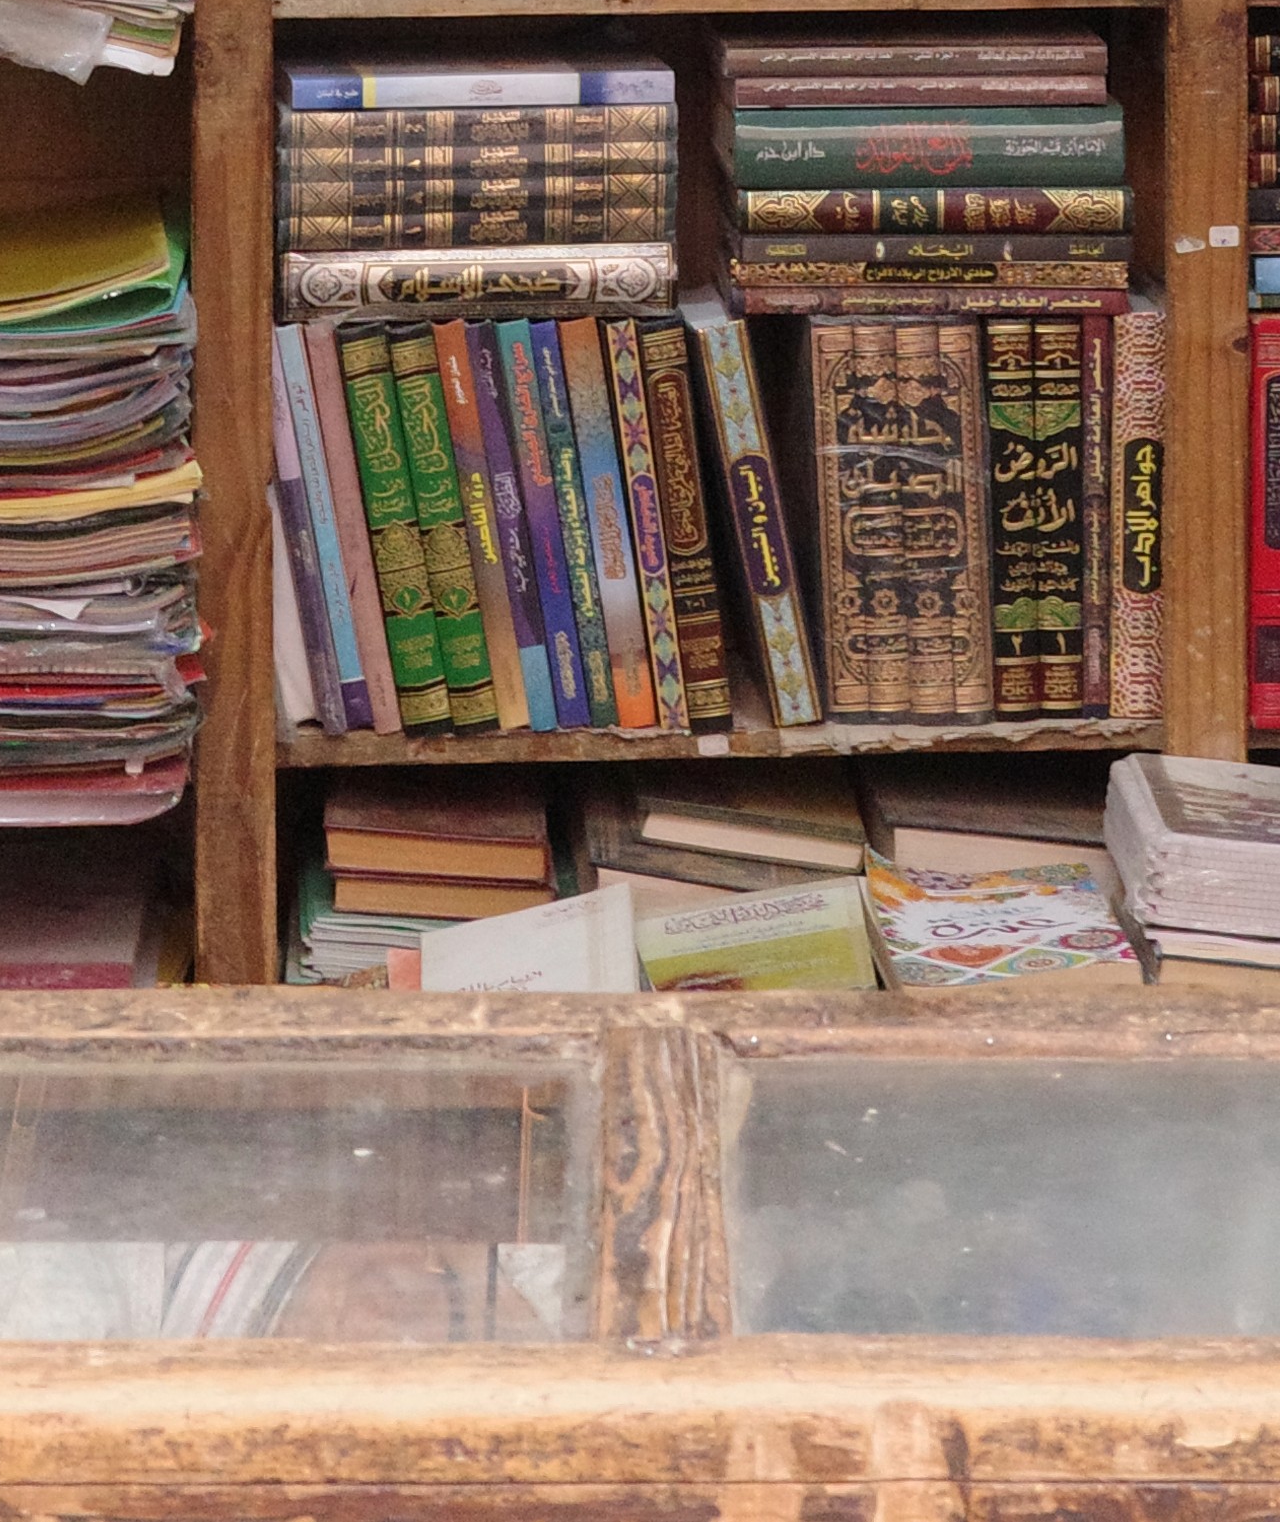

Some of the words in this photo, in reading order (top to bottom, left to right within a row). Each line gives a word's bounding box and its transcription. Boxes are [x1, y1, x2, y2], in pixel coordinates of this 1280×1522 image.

[1129, 444, 1158, 504] جواهر
[738, 463, 767, 515] البيان
[753, 528, 782, 588] التبيين
[1128, 504, 1158, 588] الأدب
